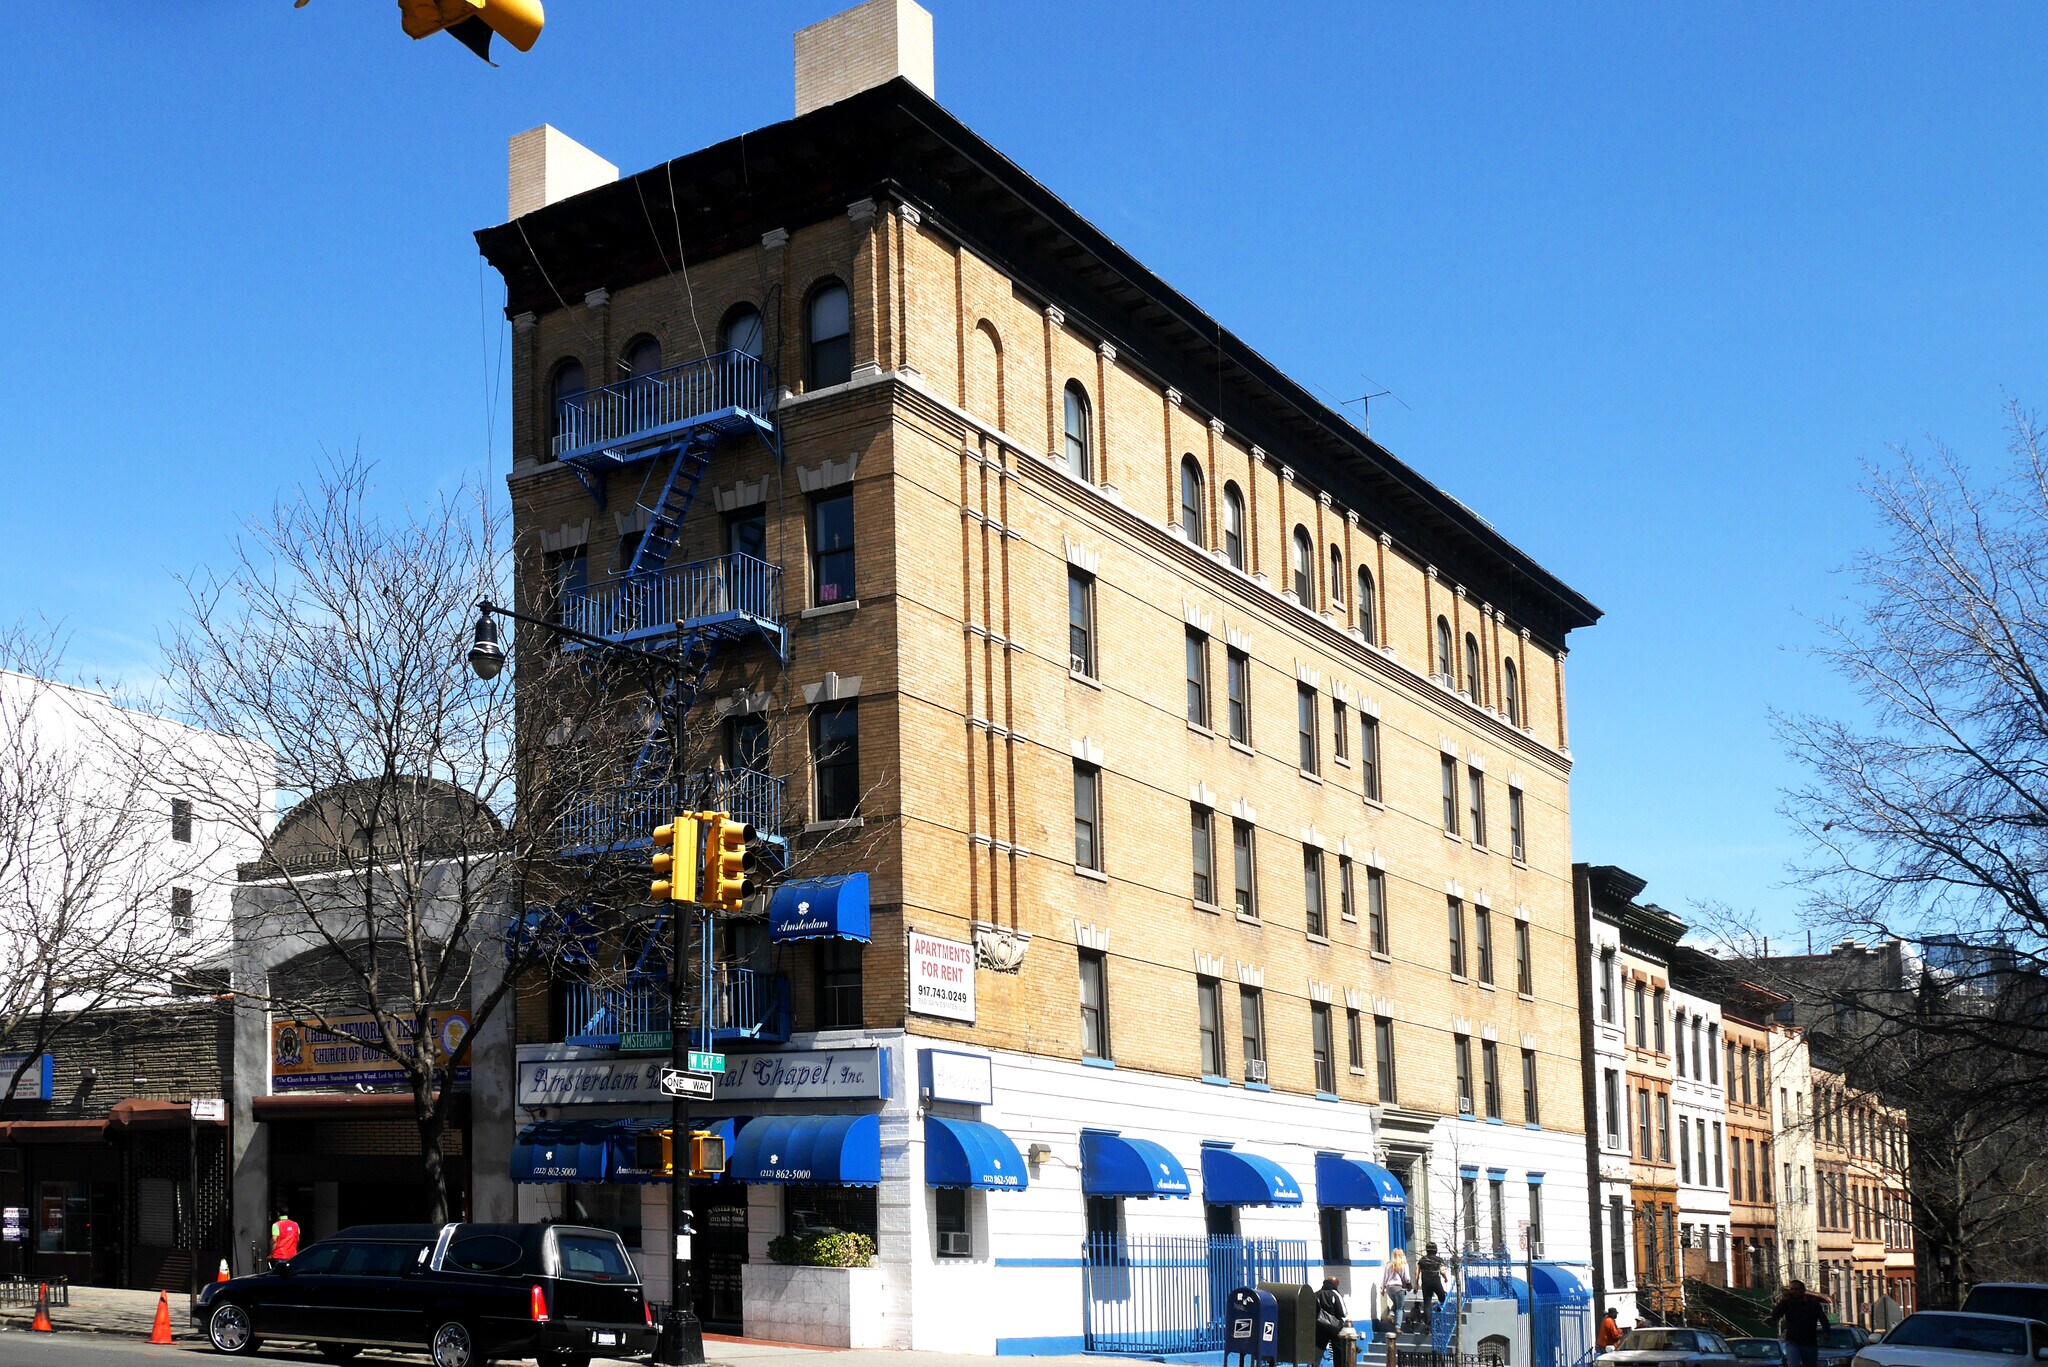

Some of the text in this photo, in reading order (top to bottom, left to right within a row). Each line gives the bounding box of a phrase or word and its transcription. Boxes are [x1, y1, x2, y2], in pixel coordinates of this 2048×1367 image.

[777, 918, 828, 932] Amsterdam
[915, 938, 971, 965] APARTMENTS
[921, 960, 963, 983] FOR RENT
[918, 984, 967, 1003] 917.743.0249
[621, 1032, 663, 1048] AMSTERDAM
[313, 1046, 347, 1063] CHURCH
[349, 1045, 360, 1061] OF
[362, 1044, 380, 1061] GOD
[690, 1053, 723, 1070] W 147 ST
[287, 1075, 303, 1083] Church
[309, 1074, 317, 1082] the
[330, 1074, 348, 1083] Standing
[378, 1071, 388, 1079] Led
[388, 1070, 395, 1079] by
[531, 1064, 639, 1093] Amsterdam
[840, 1065, 865, 1084] Inc.
[667, 1077, 709, 1091] ONE WAY
[533, 1167, 577, 1177] (212) 862-5000
[760, 1169, 811, 1179] (212) 862-5000
[994, 1175, 1018, 1185] 862-5000
